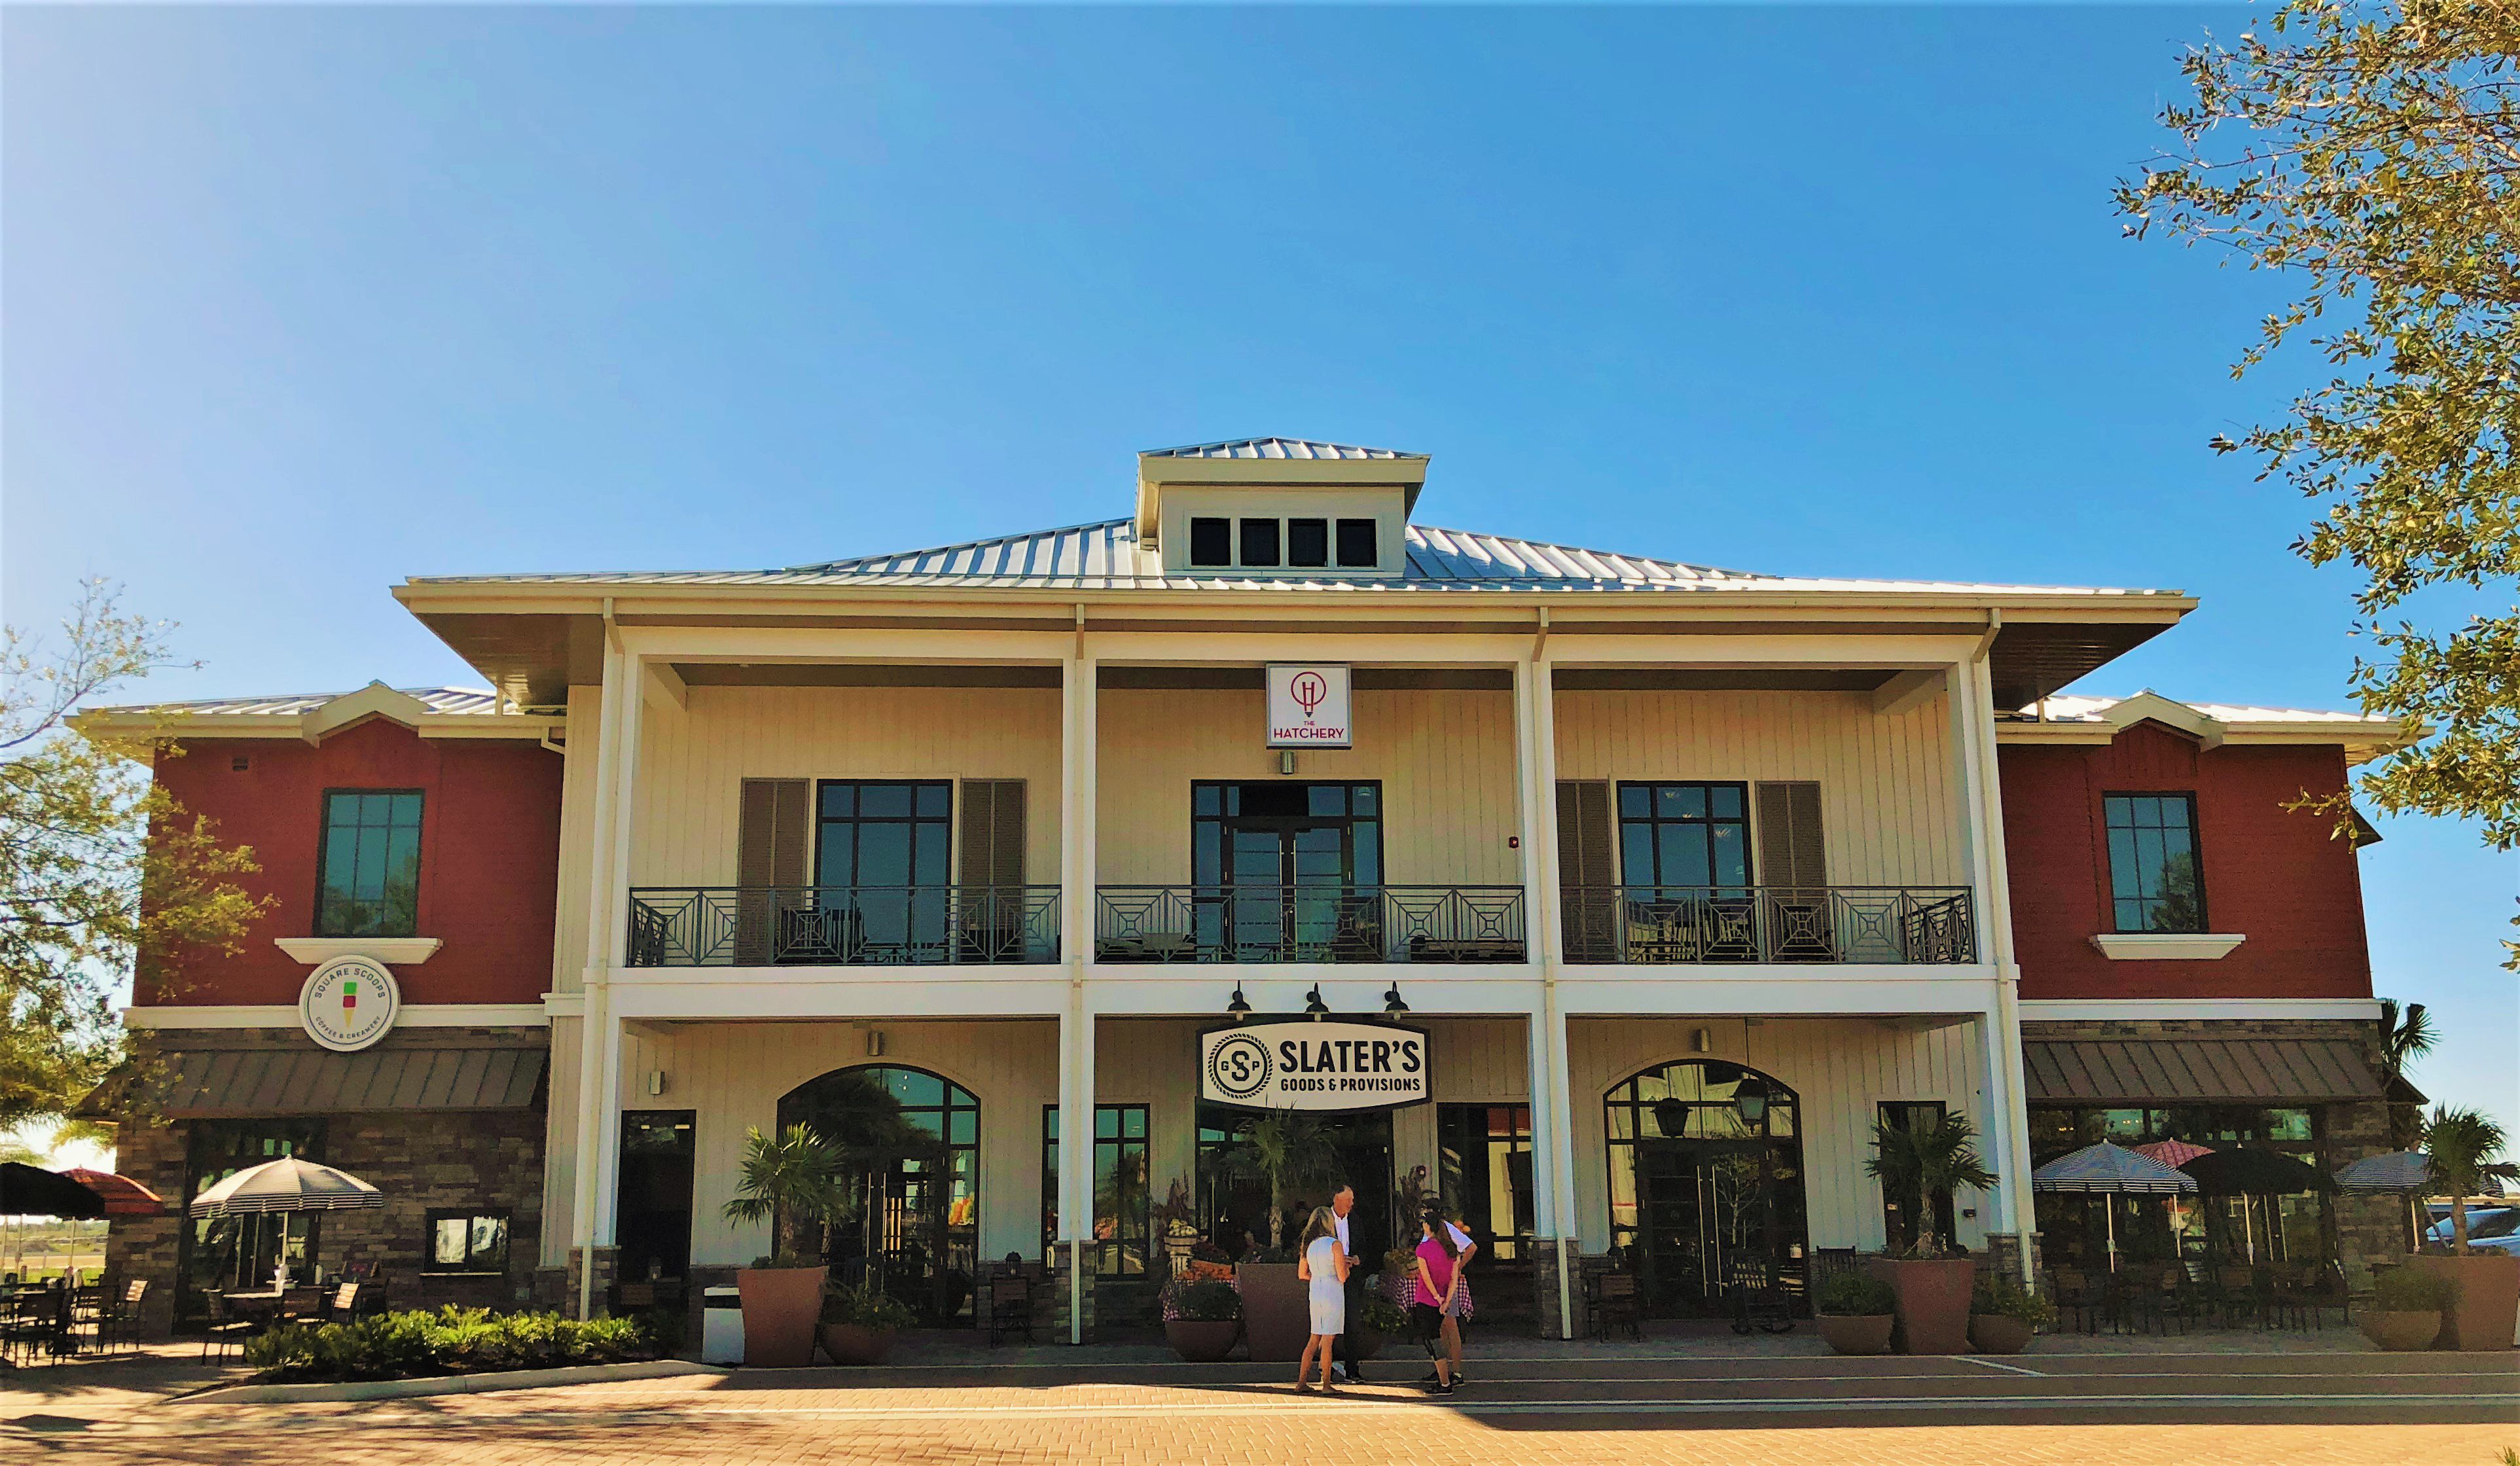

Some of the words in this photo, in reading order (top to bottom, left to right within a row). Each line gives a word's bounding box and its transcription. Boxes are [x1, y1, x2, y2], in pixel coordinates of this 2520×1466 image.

[1274, 728, 1344, 739] HATCHERY
[315, 968, 350, 999] SQUARE
[353, 968, 386, 999] SCOOPS
[315, 1016, 336, 1038] COFFEE
[347, 1016, 381, 1039] CREAMERY
[1280, 1040, 1420, 1073] SLATER'S
[1280, 1078, 1325, 1092] GOODS
[1329, 1078, 1337, 1092] &
[1341, 1078, 1420, 1092] PROVISIONS
